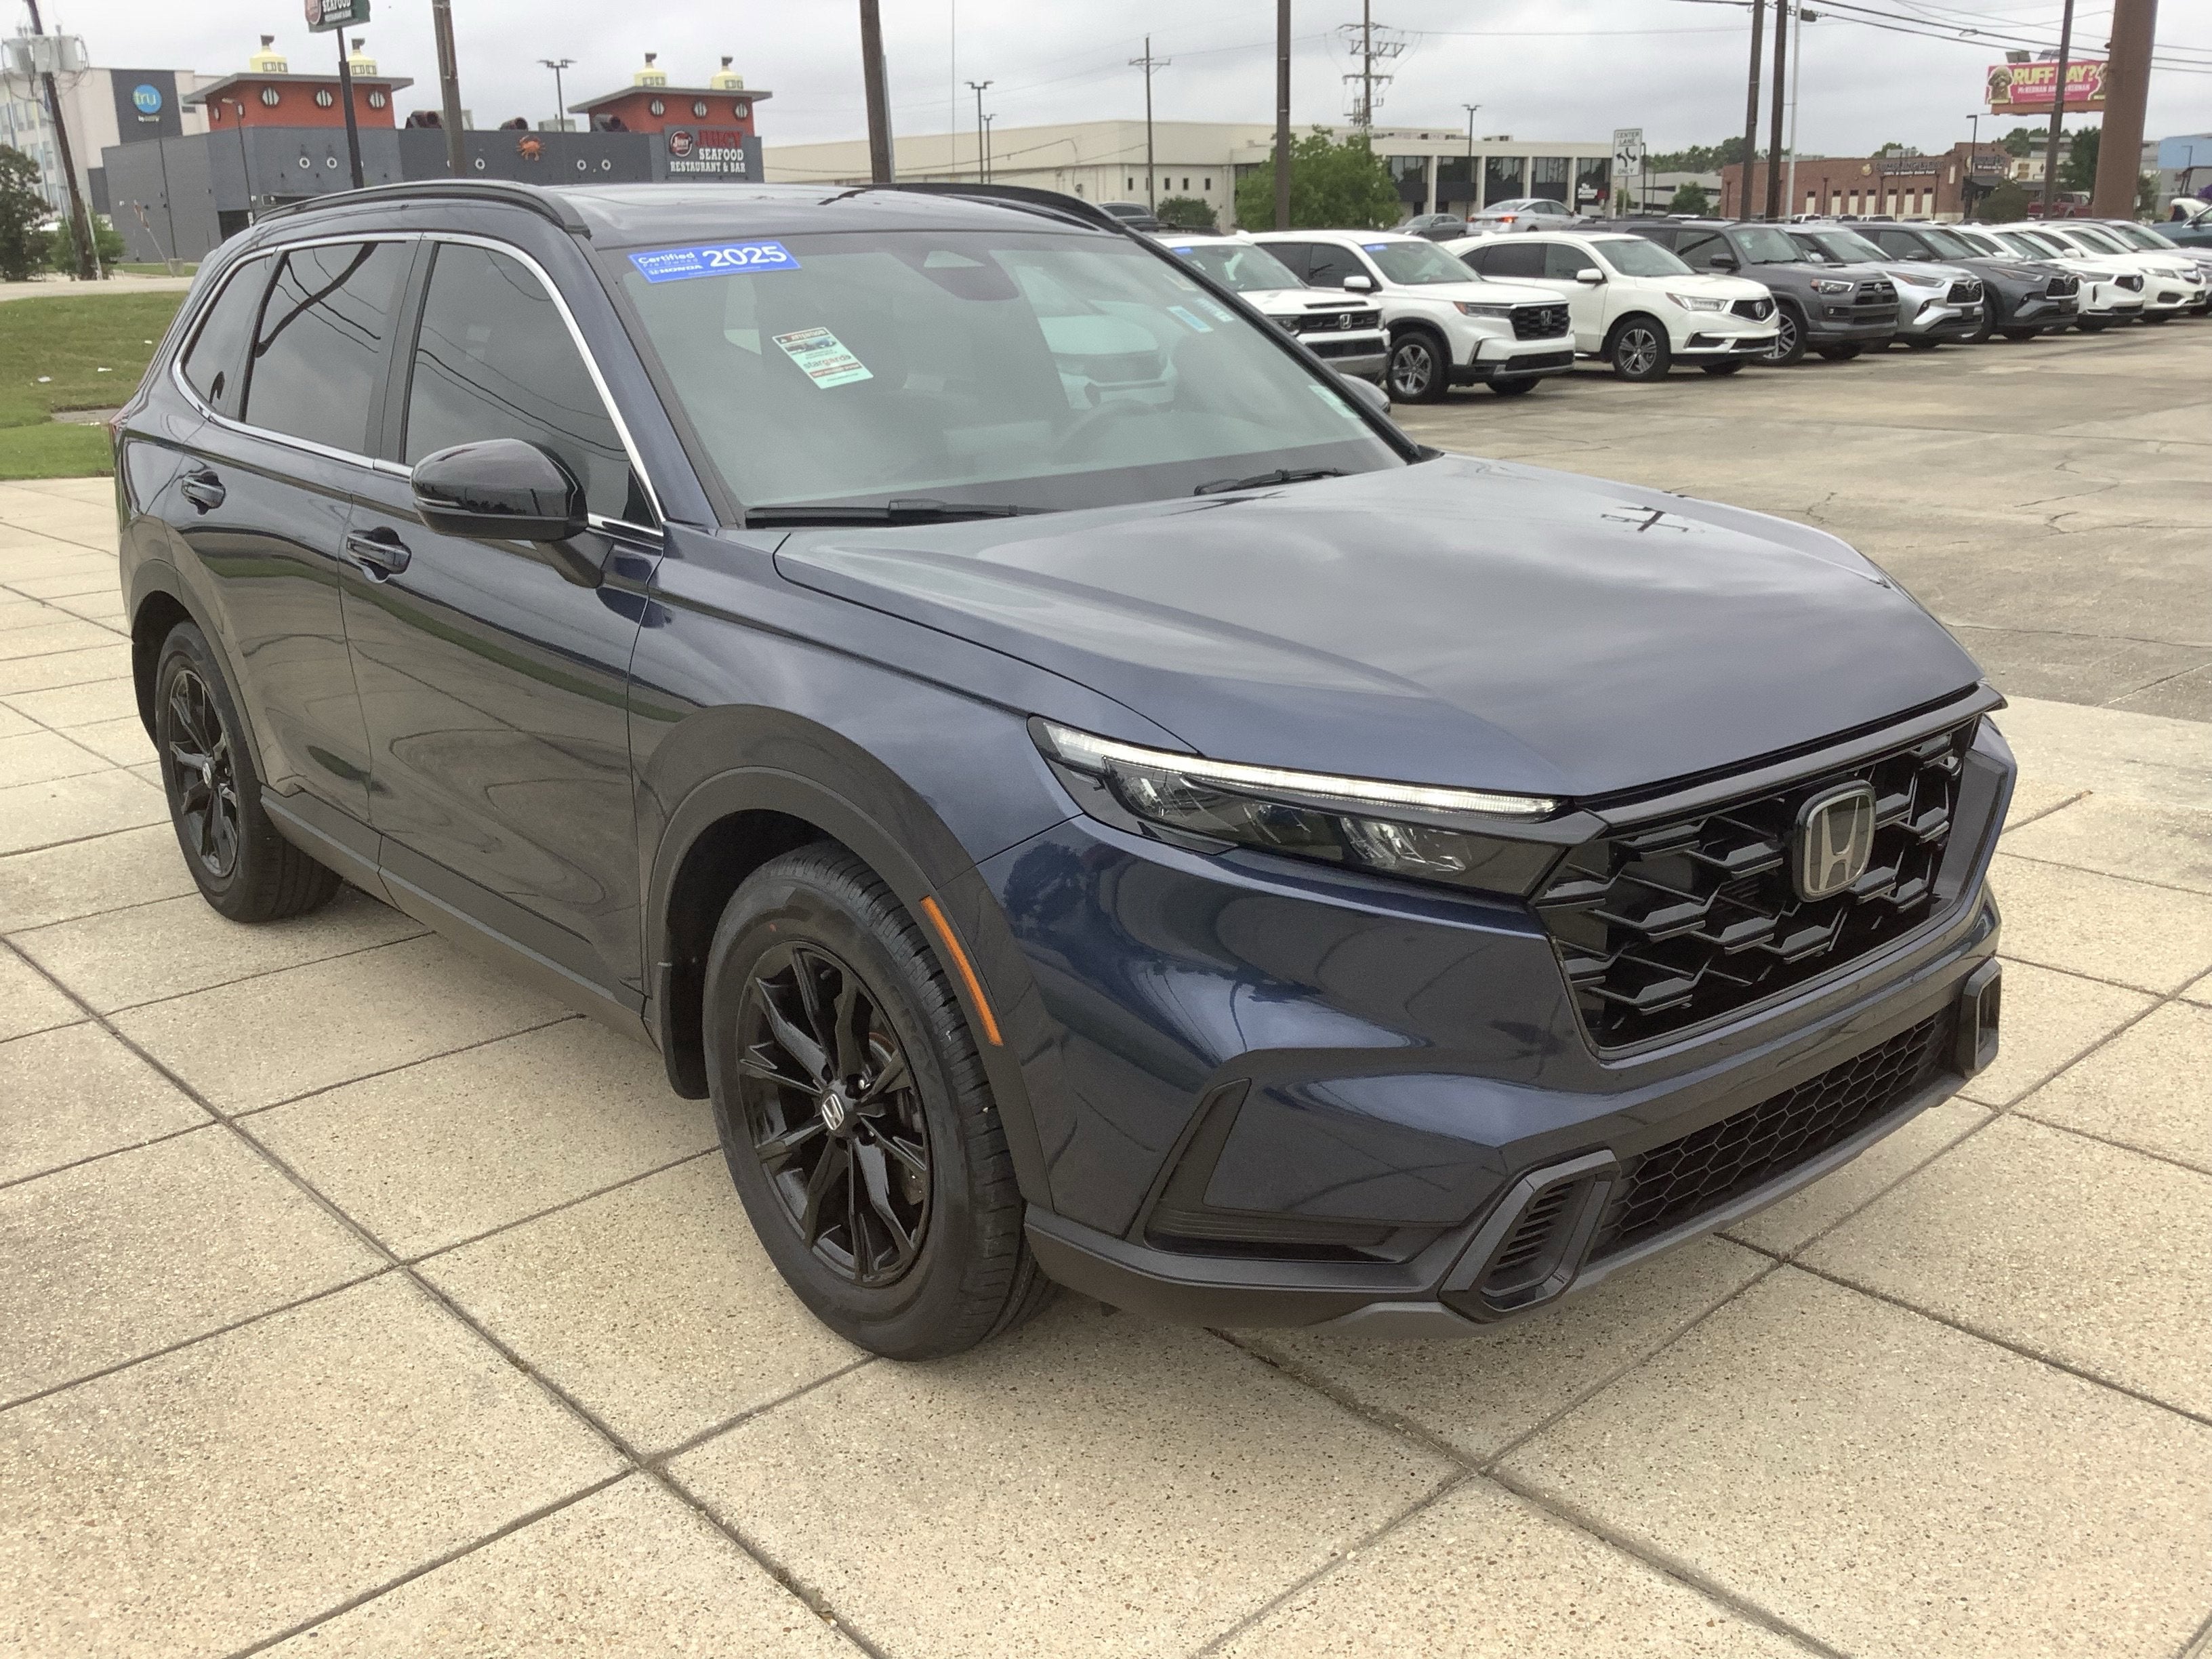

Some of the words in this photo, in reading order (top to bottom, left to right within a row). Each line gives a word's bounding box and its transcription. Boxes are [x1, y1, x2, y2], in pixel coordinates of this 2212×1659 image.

[2013, 67, 2055, 85] RUFF
[2055, 64, 2097, 84] AY?
[133, 89, 157, 106] tru
[695, 129, 742, 148] JUICY
[699, 148, 744, 161] SEAFOOD
[670, 161, 721, 172] RESTAURANT
[722, 161, 729, 172] &
[730, 162, 746, 173] BAR
[638, 251, 695, 264] Certified
[702, 246, 787, 267] 2025
[659, 265, 704, 273] HONDA
